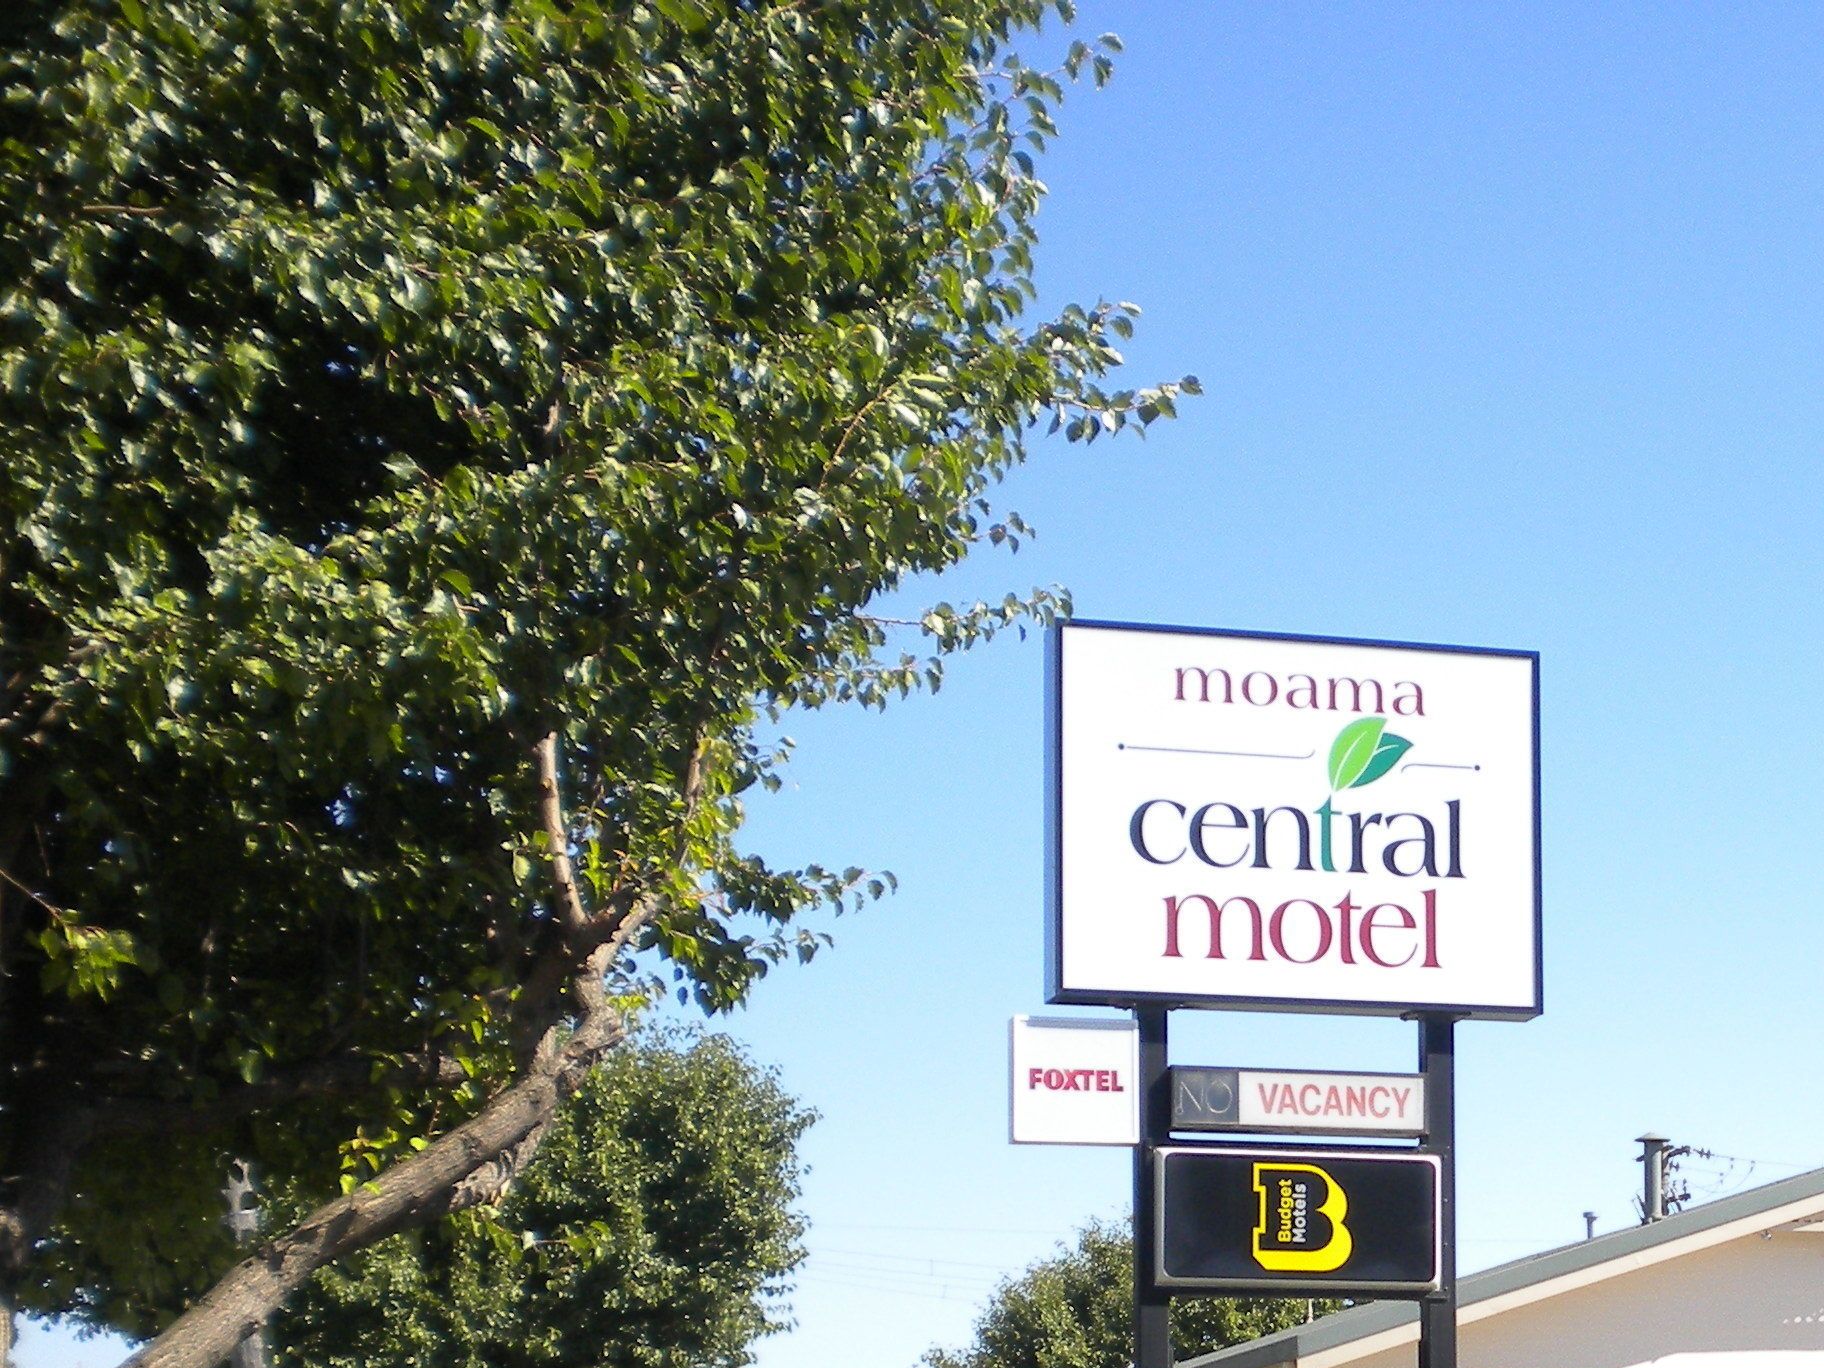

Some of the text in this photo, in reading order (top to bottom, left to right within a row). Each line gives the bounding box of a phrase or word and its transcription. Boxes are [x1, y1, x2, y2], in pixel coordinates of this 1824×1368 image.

[1174, 666, 1427, 717] moama
[1128, 794, 1467, 879] central
[1161, 888, 1443, 969] motel
[1028, 1067, 1125, 1093] FOXTEL
[1175, 1079, 1411, 1119] NO VACANCY
[1277, 1179, 1294, 1243] Budget
[1292, 1183, 1307, 1243] Motels
